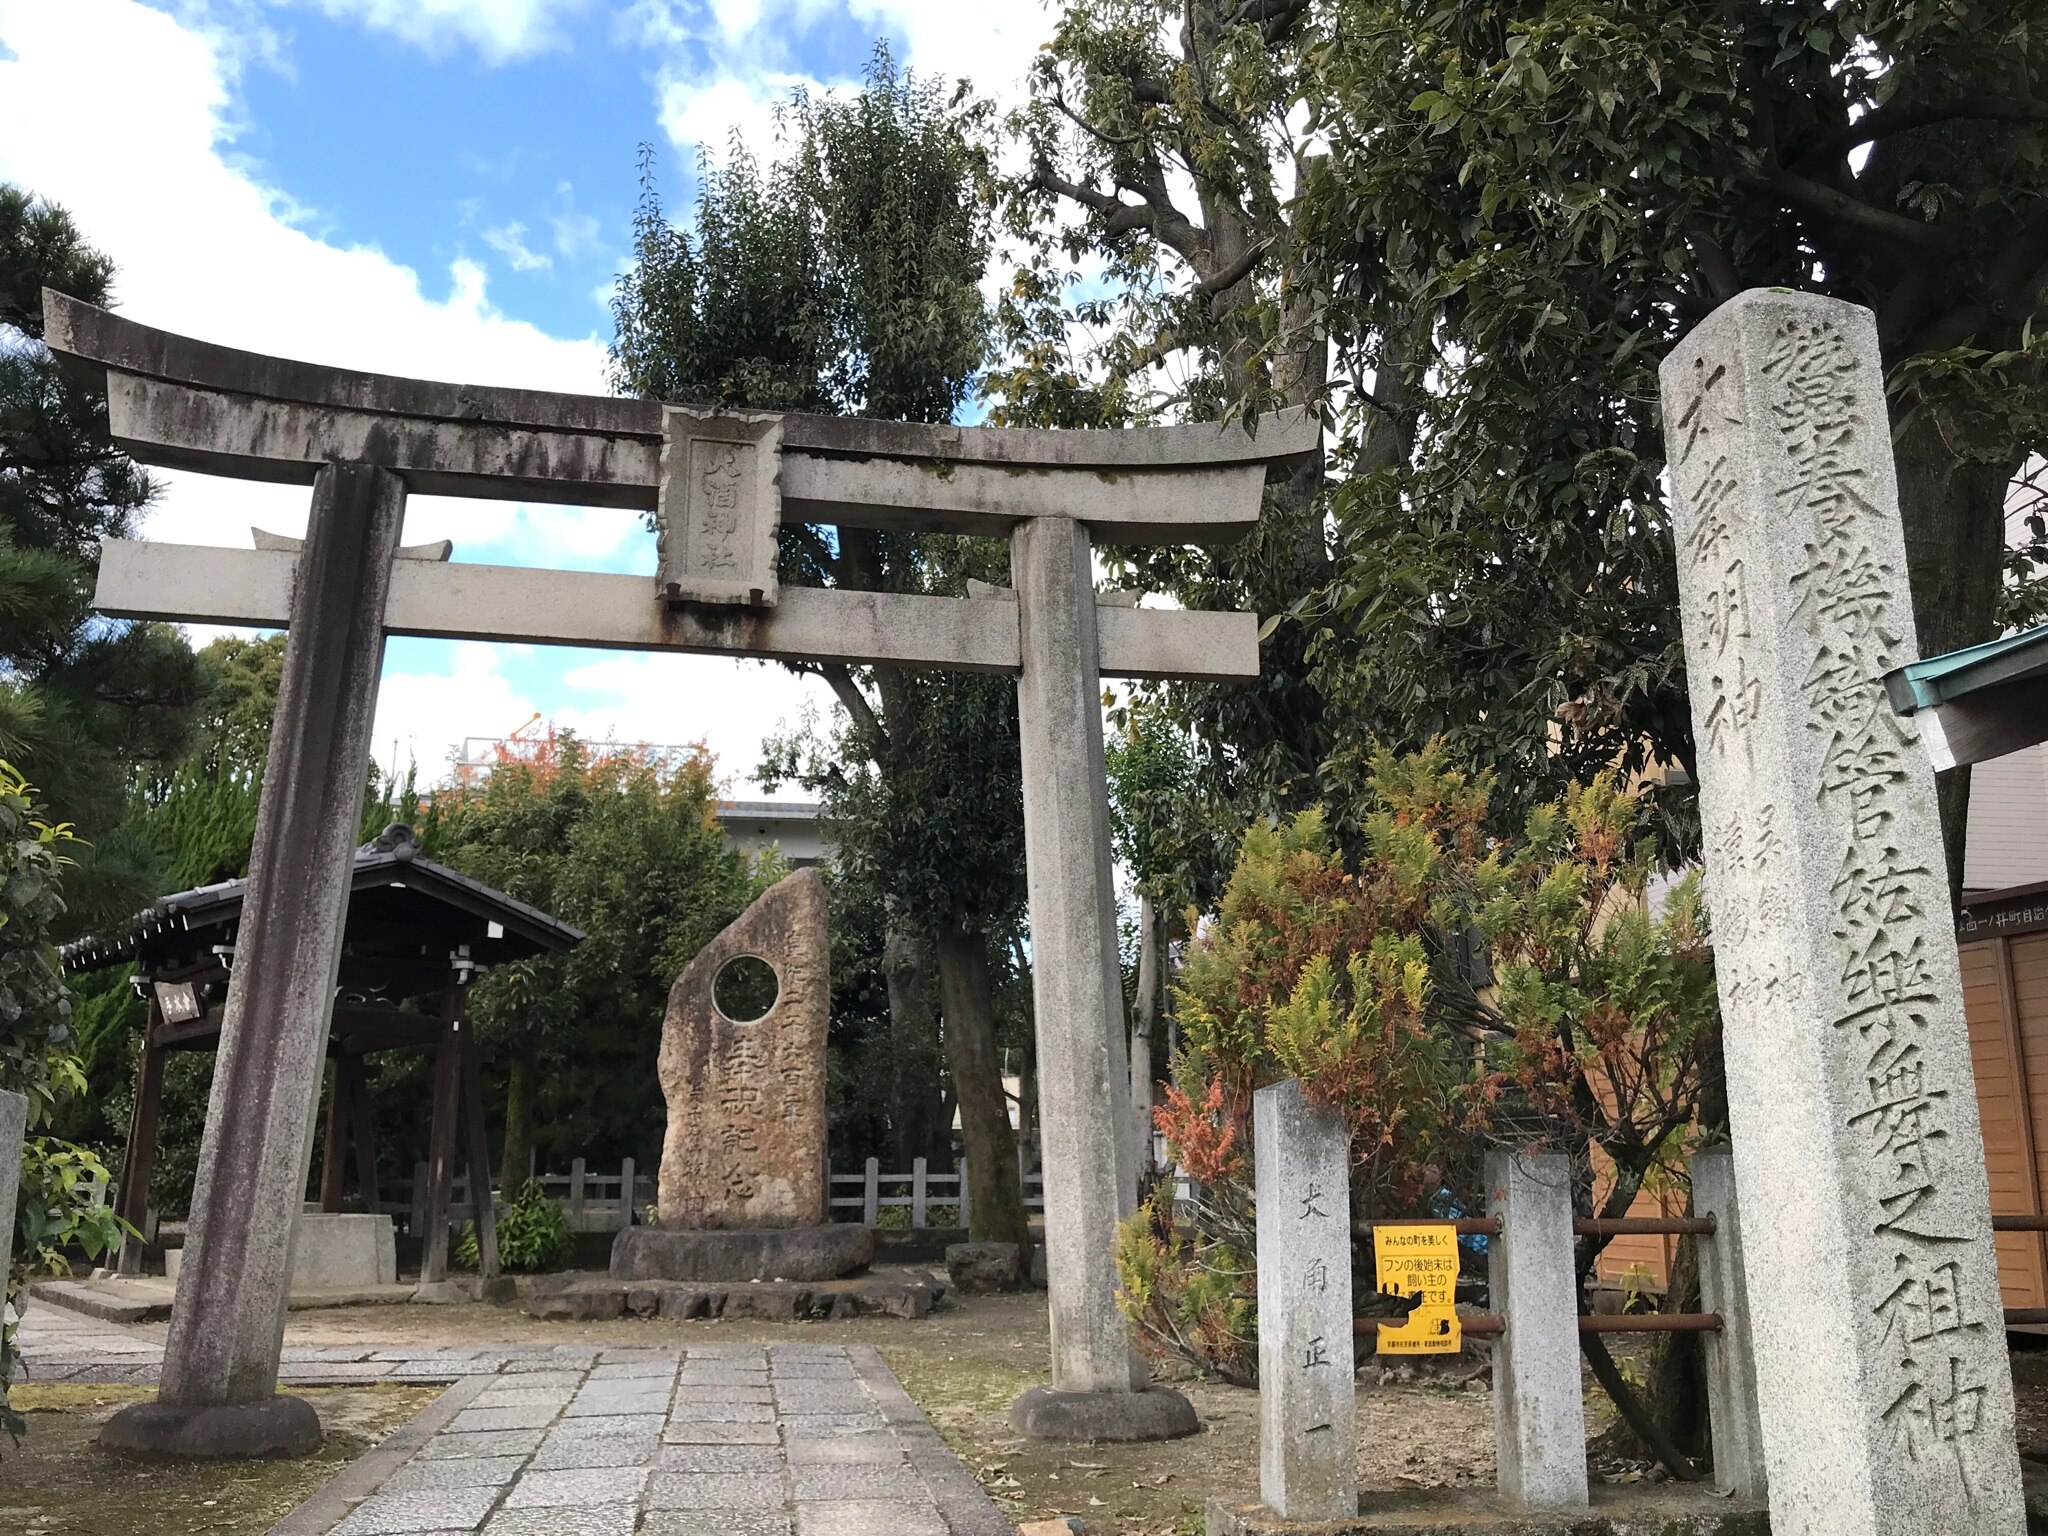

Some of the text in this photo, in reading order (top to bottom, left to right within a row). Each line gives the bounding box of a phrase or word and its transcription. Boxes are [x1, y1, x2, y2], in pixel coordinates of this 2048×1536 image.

[1958, 906, 2048, 932] 西一ノ井町自治
[719, 1034, 767, 1203] 奉祝記念
[1385, 1234, 1449, 1247] みんなの町を美しく
[1384, 1258, 1453, 1273] フンの後始末は
[1407, 1273, 1447, 1287] 飼い主の
[1299, 1182, 1335, 1437] 大角正一
